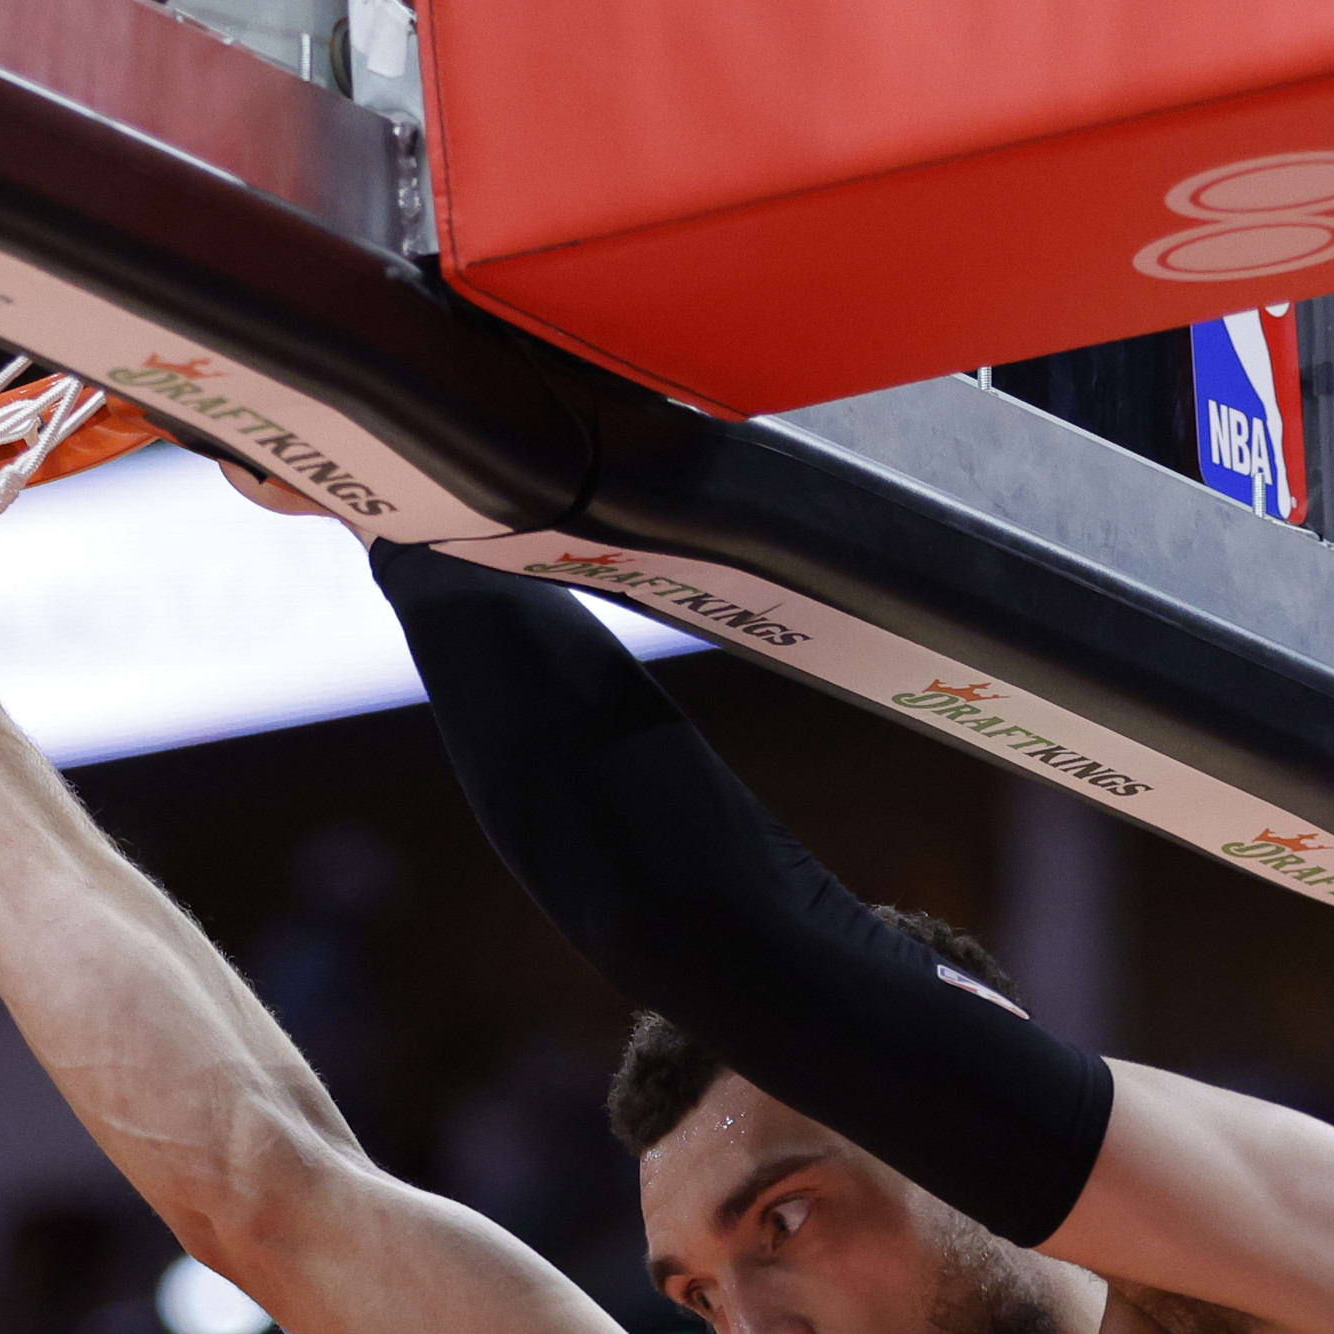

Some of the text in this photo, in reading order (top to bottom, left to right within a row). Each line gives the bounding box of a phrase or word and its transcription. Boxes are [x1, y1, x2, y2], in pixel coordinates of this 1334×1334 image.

[107, 367, 399, 517] DRAFTKINGS
[1208, 399, 1273, 486] NBA
[523, 562, 813, 647] DRAFTKINGS
[891, 692, 1155, 797] DRAFTKINGS
